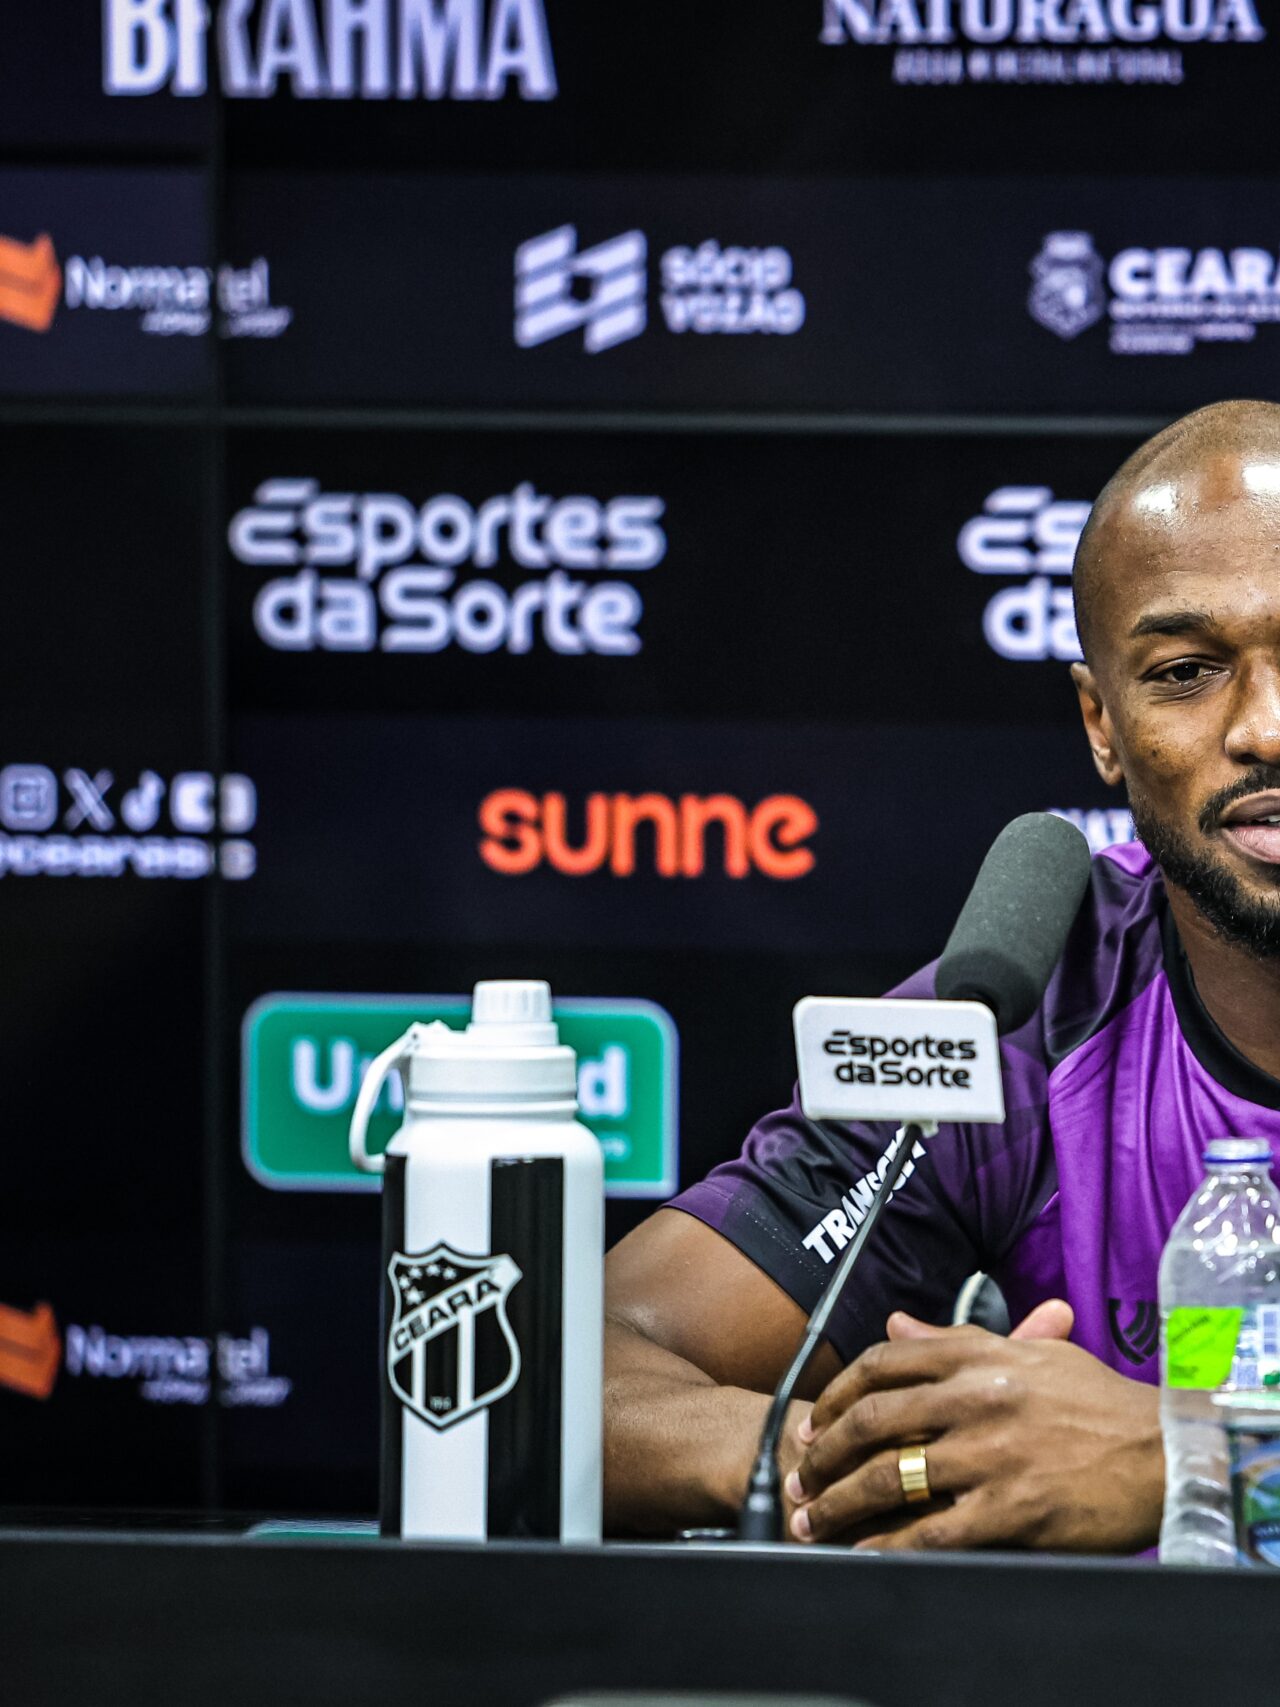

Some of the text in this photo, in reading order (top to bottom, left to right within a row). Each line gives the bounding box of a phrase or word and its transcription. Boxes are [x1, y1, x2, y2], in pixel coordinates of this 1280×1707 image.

[103, 0, 557, 98] BRAHMA
[479, 788, 818, 880] sunne
[823, 1030, 977, 1061] Esportes
